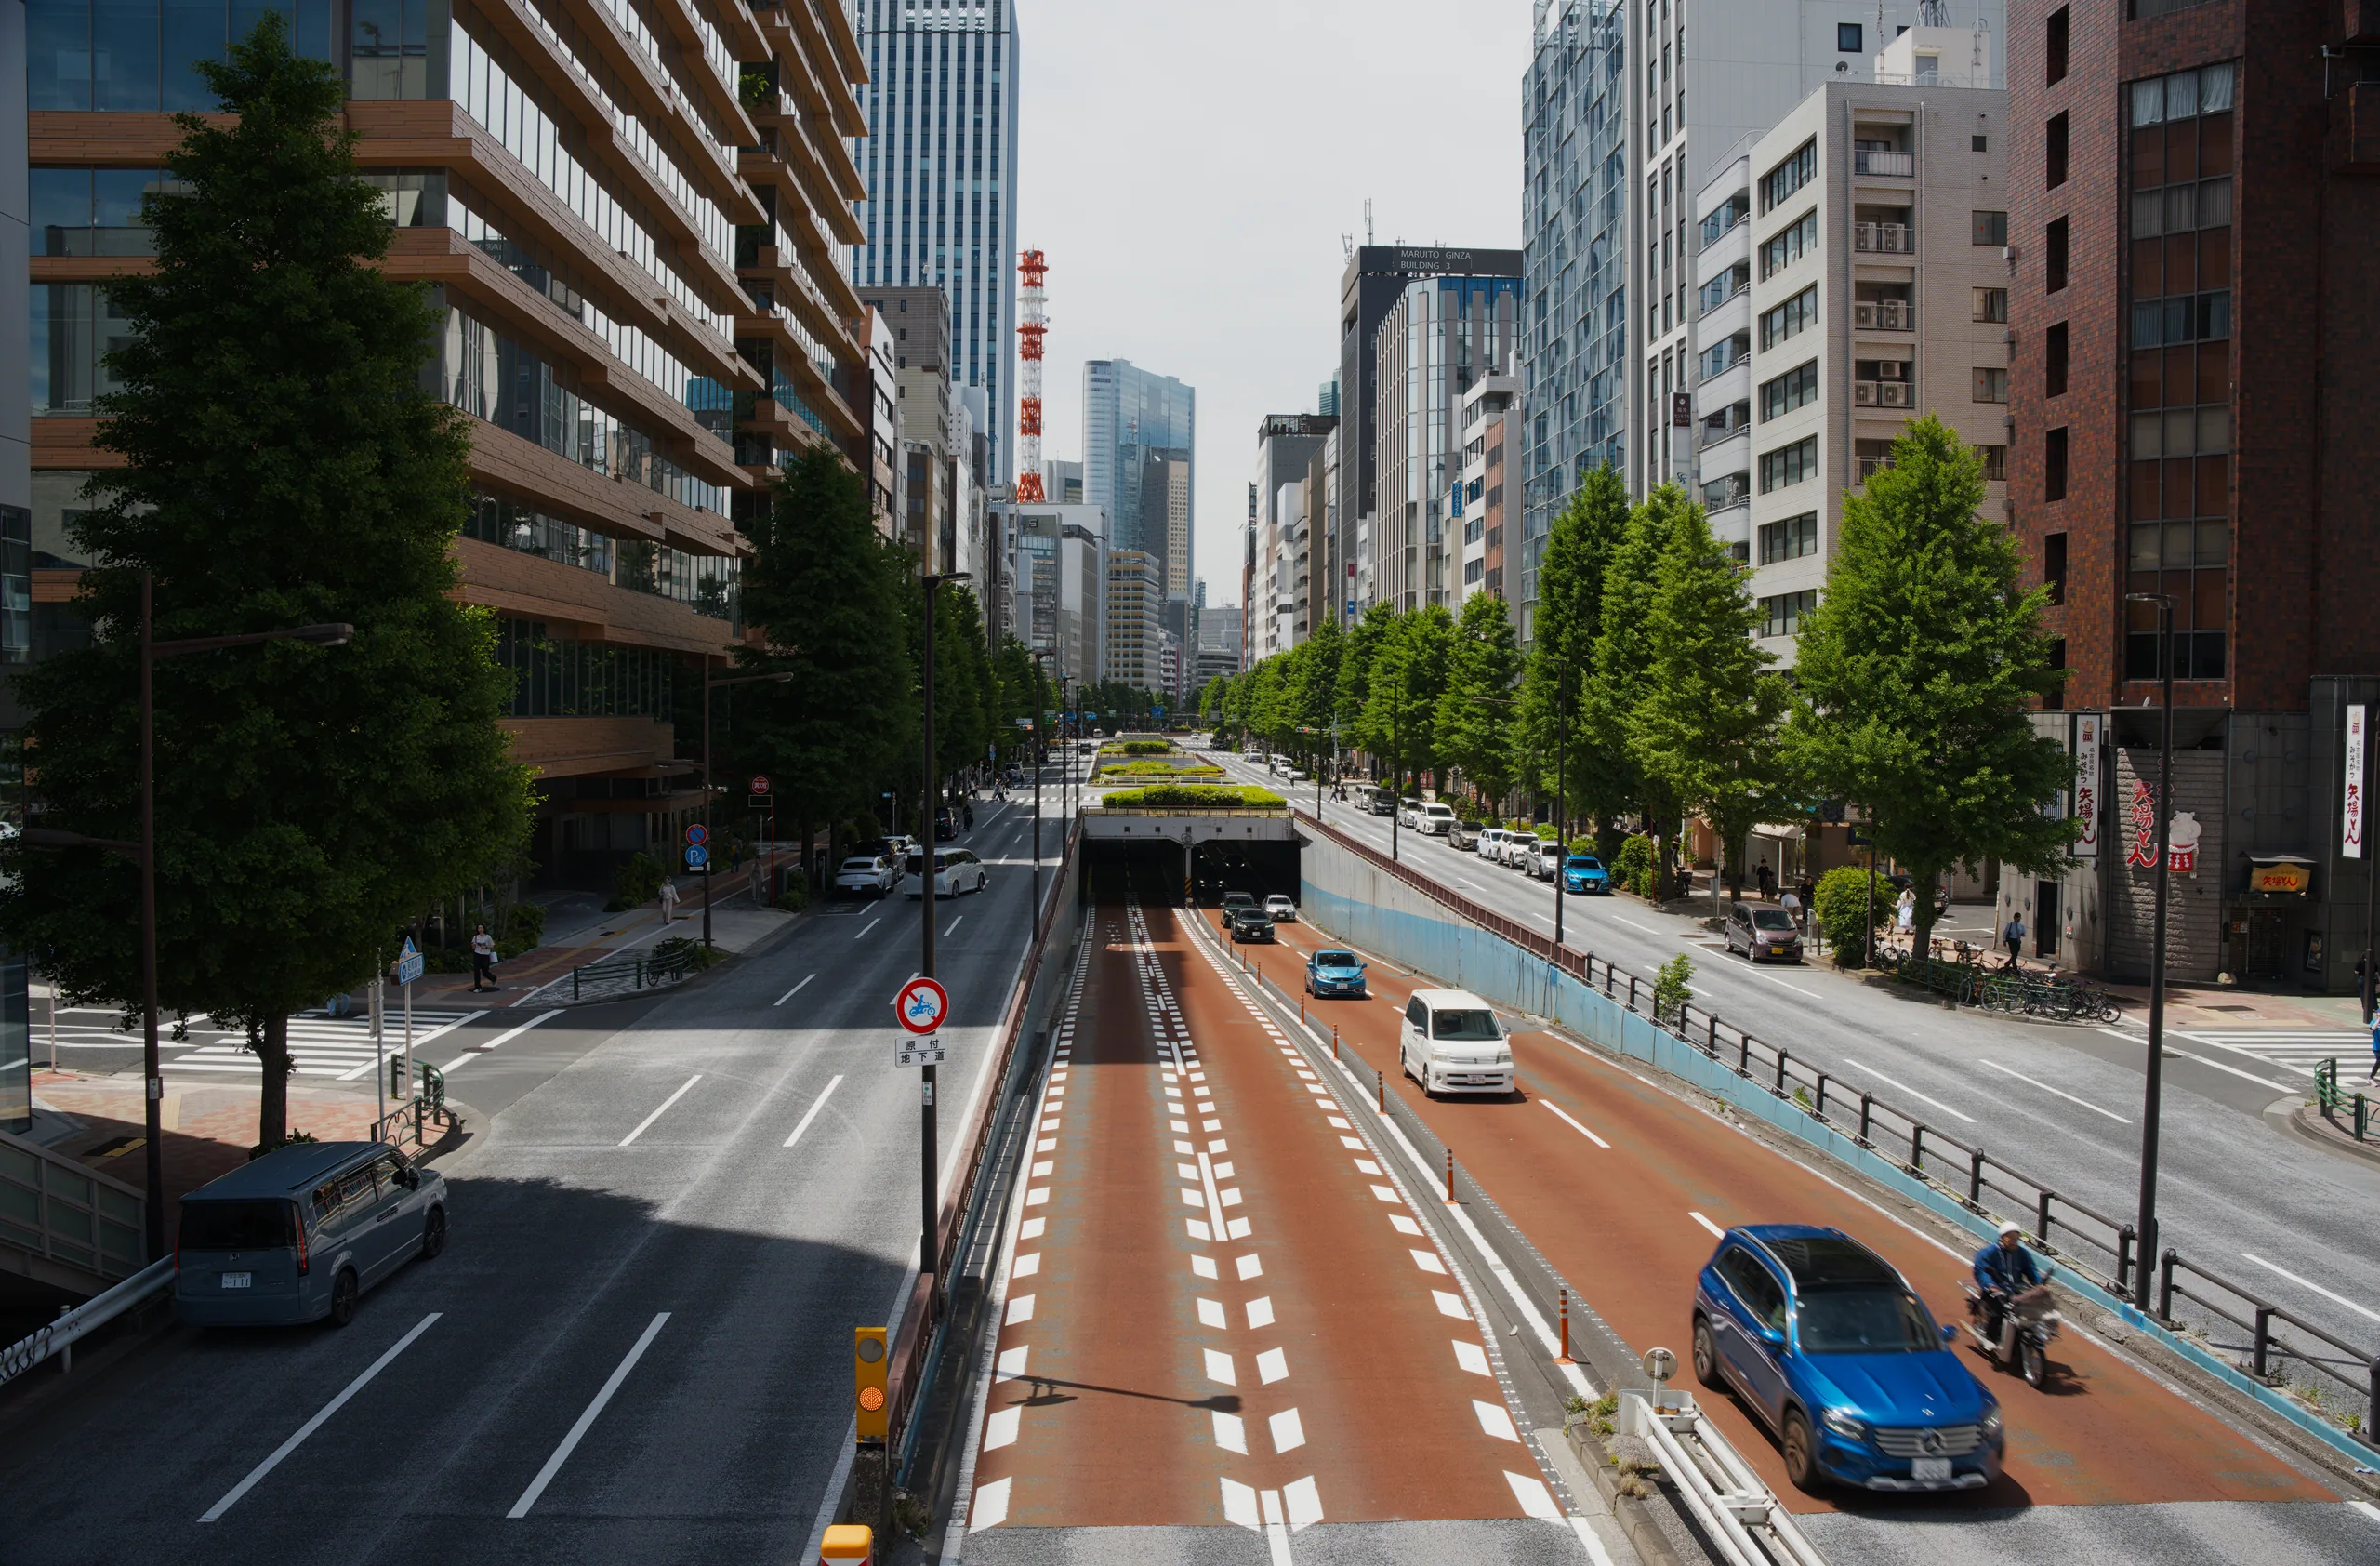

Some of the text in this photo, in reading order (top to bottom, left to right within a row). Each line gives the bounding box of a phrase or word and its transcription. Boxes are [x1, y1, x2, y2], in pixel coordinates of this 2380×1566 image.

[1400, 249, 1471, 259] MARUITO GINZA
[1400, 260, 1440, 270] BUILDING
[2080, 752, 2088, 784] みそかつ
[2075, 787, 2096, 845] 矢場とん
[2345, 783, 2360, 845] 矢場とん
[2126, 778, 2159, 868] 矢場とん
[2262, 875, 2298, 887] 矢場とん
[906, 1039, 940, 1051] 原付
[900, 1051, 945, 1064] 地下道
